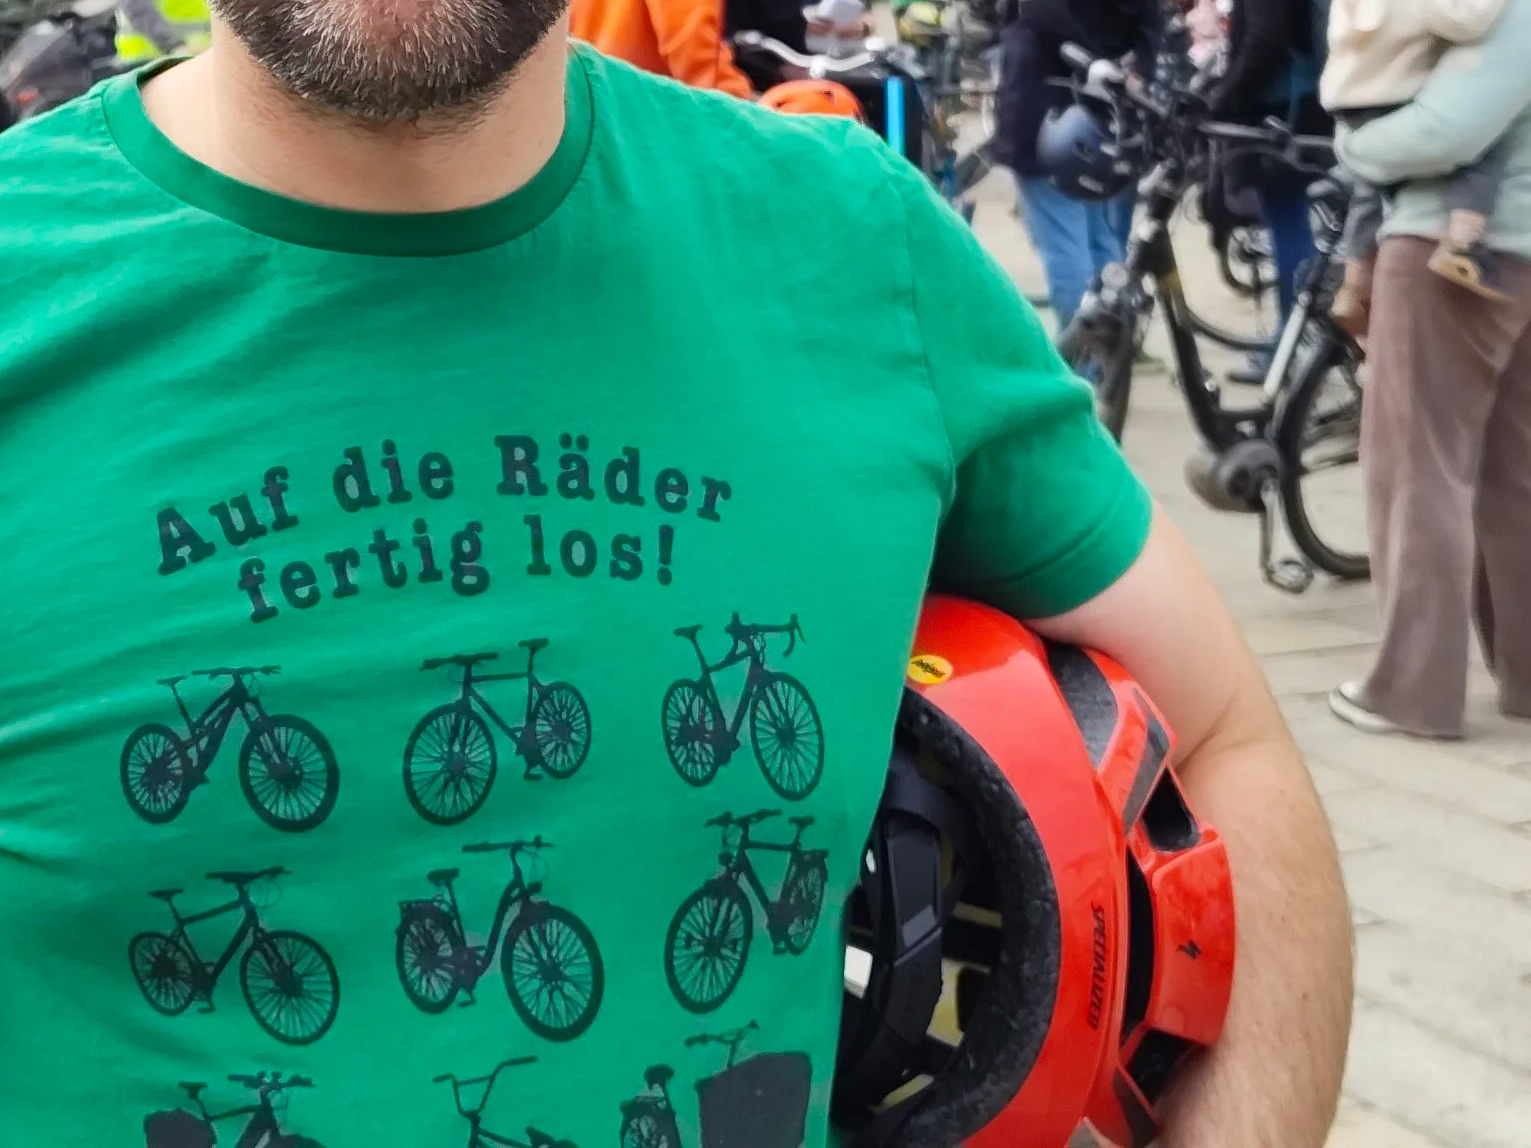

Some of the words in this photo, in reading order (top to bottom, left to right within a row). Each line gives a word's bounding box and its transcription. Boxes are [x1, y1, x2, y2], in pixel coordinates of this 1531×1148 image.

[158, 466, 299, 575] Auf
[333, 439, 454, 512] die
[494, 433, 732, 522] Räder
[238, 518, 490, 623] fertig
[523, 514, 674, 586] los!
[1088, 901, 1106, 1029] SPECIALIZED
